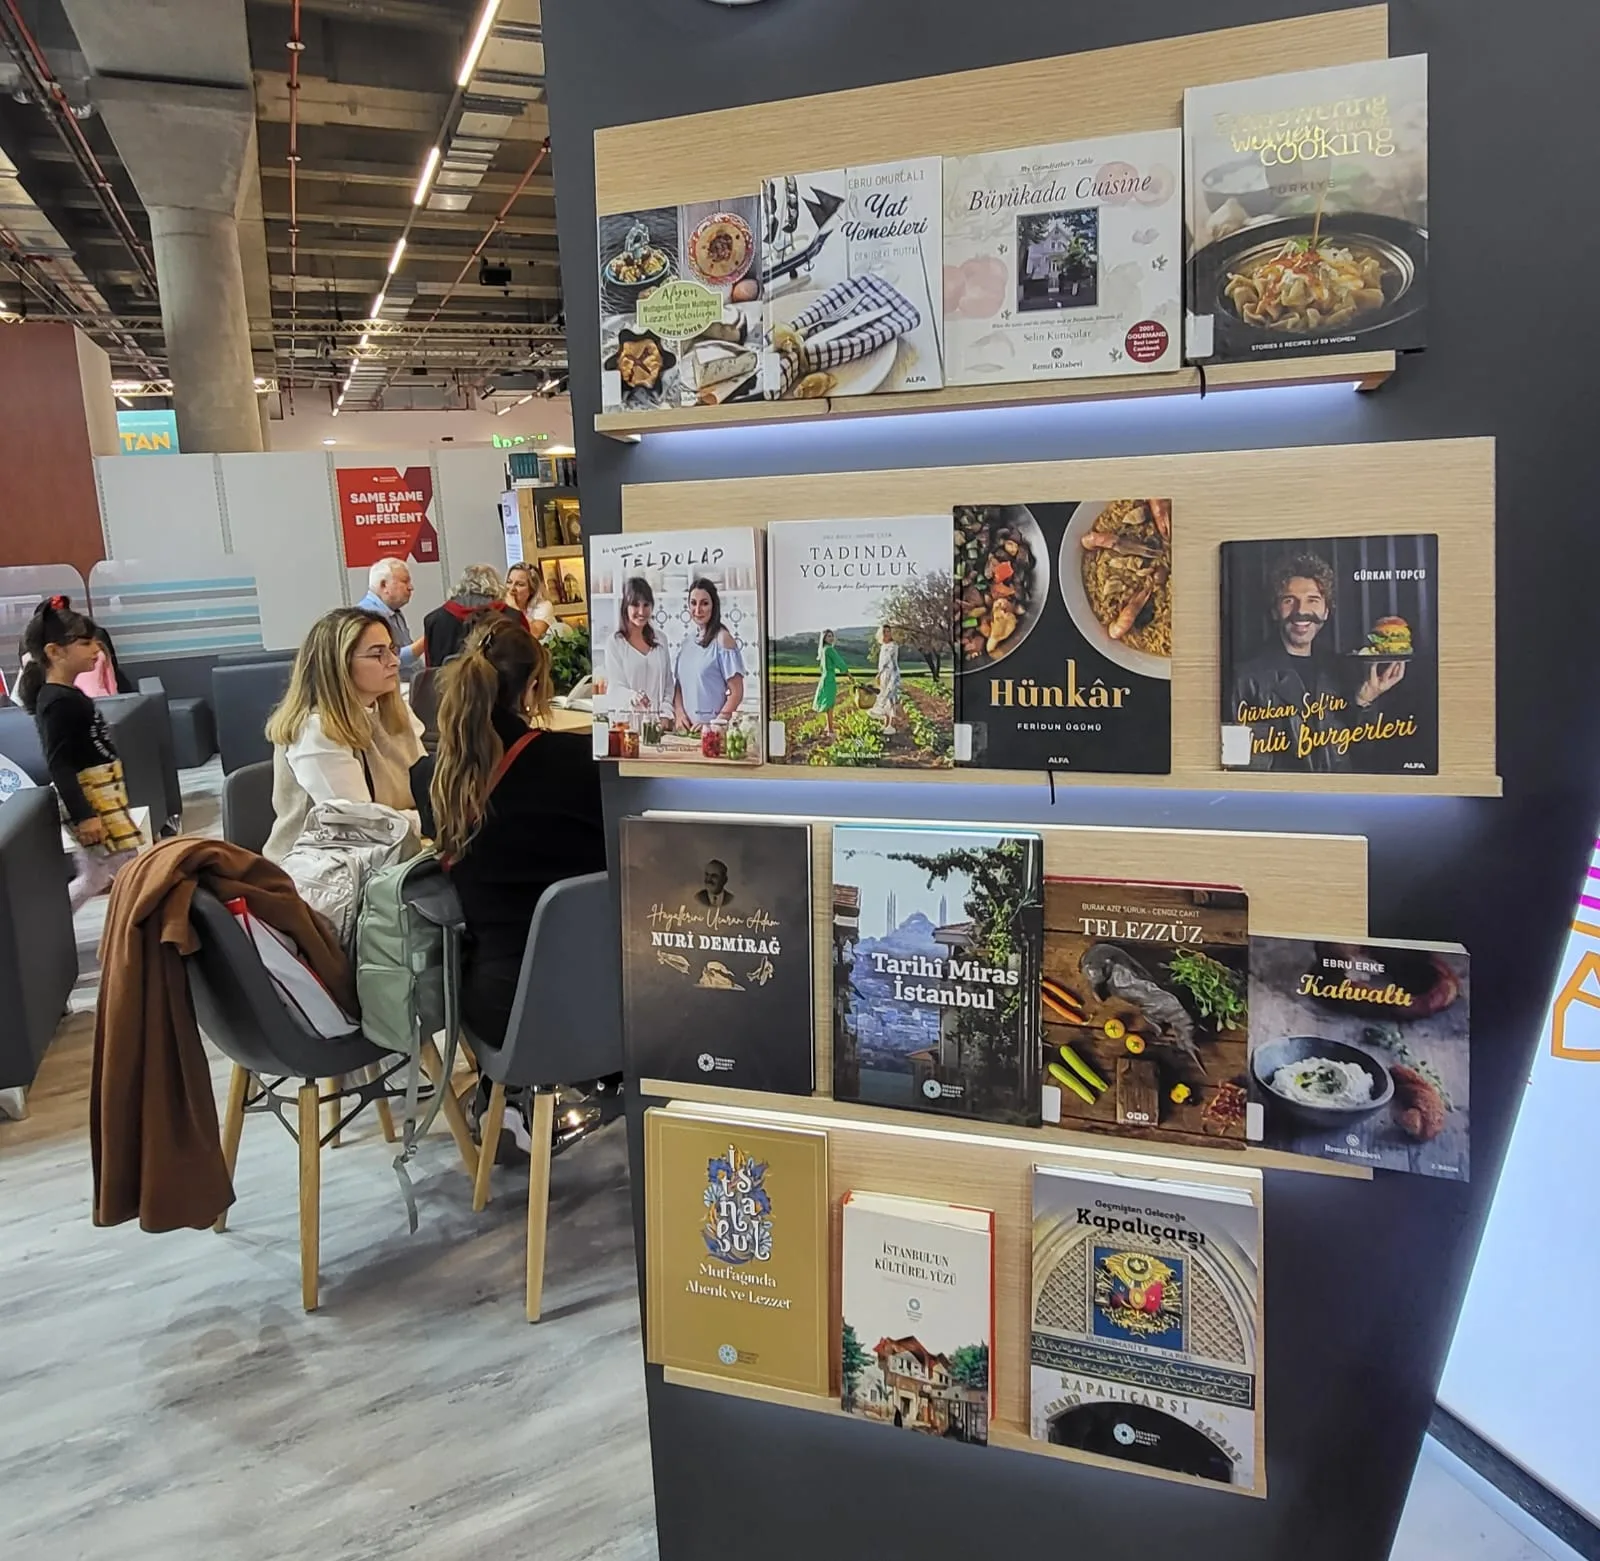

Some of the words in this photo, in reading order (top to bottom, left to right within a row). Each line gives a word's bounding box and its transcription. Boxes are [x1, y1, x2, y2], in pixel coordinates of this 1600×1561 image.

[848, 174, 872, 190] EBRU
[968, 180, 1067, 216] Büyükada
[1075, 172, 1152, 199] Cuisine
[864, 193, 908, 219] Yat
[840, 216, 929, 242] Yemekleri
[662, 285, 698, 303] Afyon
[1284, 340, 1311, 348] RECIPES
[1329, 335, 1357, 344] WOMEN
[119, 431, 170, 451] TAN
[350, 492, 386, 504] SAME
[388, 490, 424, 502] SAME
[376, 502, 401, 513] BUT
[355, 512, 423, 526] DIFFERENT
[809, 543, 907, 560] TADINDA
[800, 561, 918, 578] YOLCULUK
[1354, 570, 1392, 581] GÜRKAN
[1396, 569, 1426, 582] TOPÇU
[990, 658, 1131, 708] Hünkâr
[1237, 700, 1297, 726] Gürkan
[1301, 692, 1348, 722] Şef'in
[1017, 722, 1061, 731] FERİDUN
[1297, 713, 1418, 759] Burgerleri
[1079, 917, 1204, 944] TELEZZÜZ
[651, 931, 694, 948] NURİ
[699, 934, 781, 955] DEMİRAĞ
[871, 952, 943, 979] Tarihî
[948, 959, 1019, 986] Miras
[1323, 958, 1352, 970] EBRU
[1355, 961, 1385, 973] ERKE
[894, 975, 996, 1010] İstanbul
[1296, 973, 1413, 1007] Kahvaltı
[1076, 1207, 1206, 1251] Kapalıçarşı
[875, 1257, 928, 1280] KÜLTÜREL
[929, 1269, 957, 1286] YÜZÜ
[730, 1289, 745, 1301] ve
[1043, 1393, 1081, 1416] GRAND
